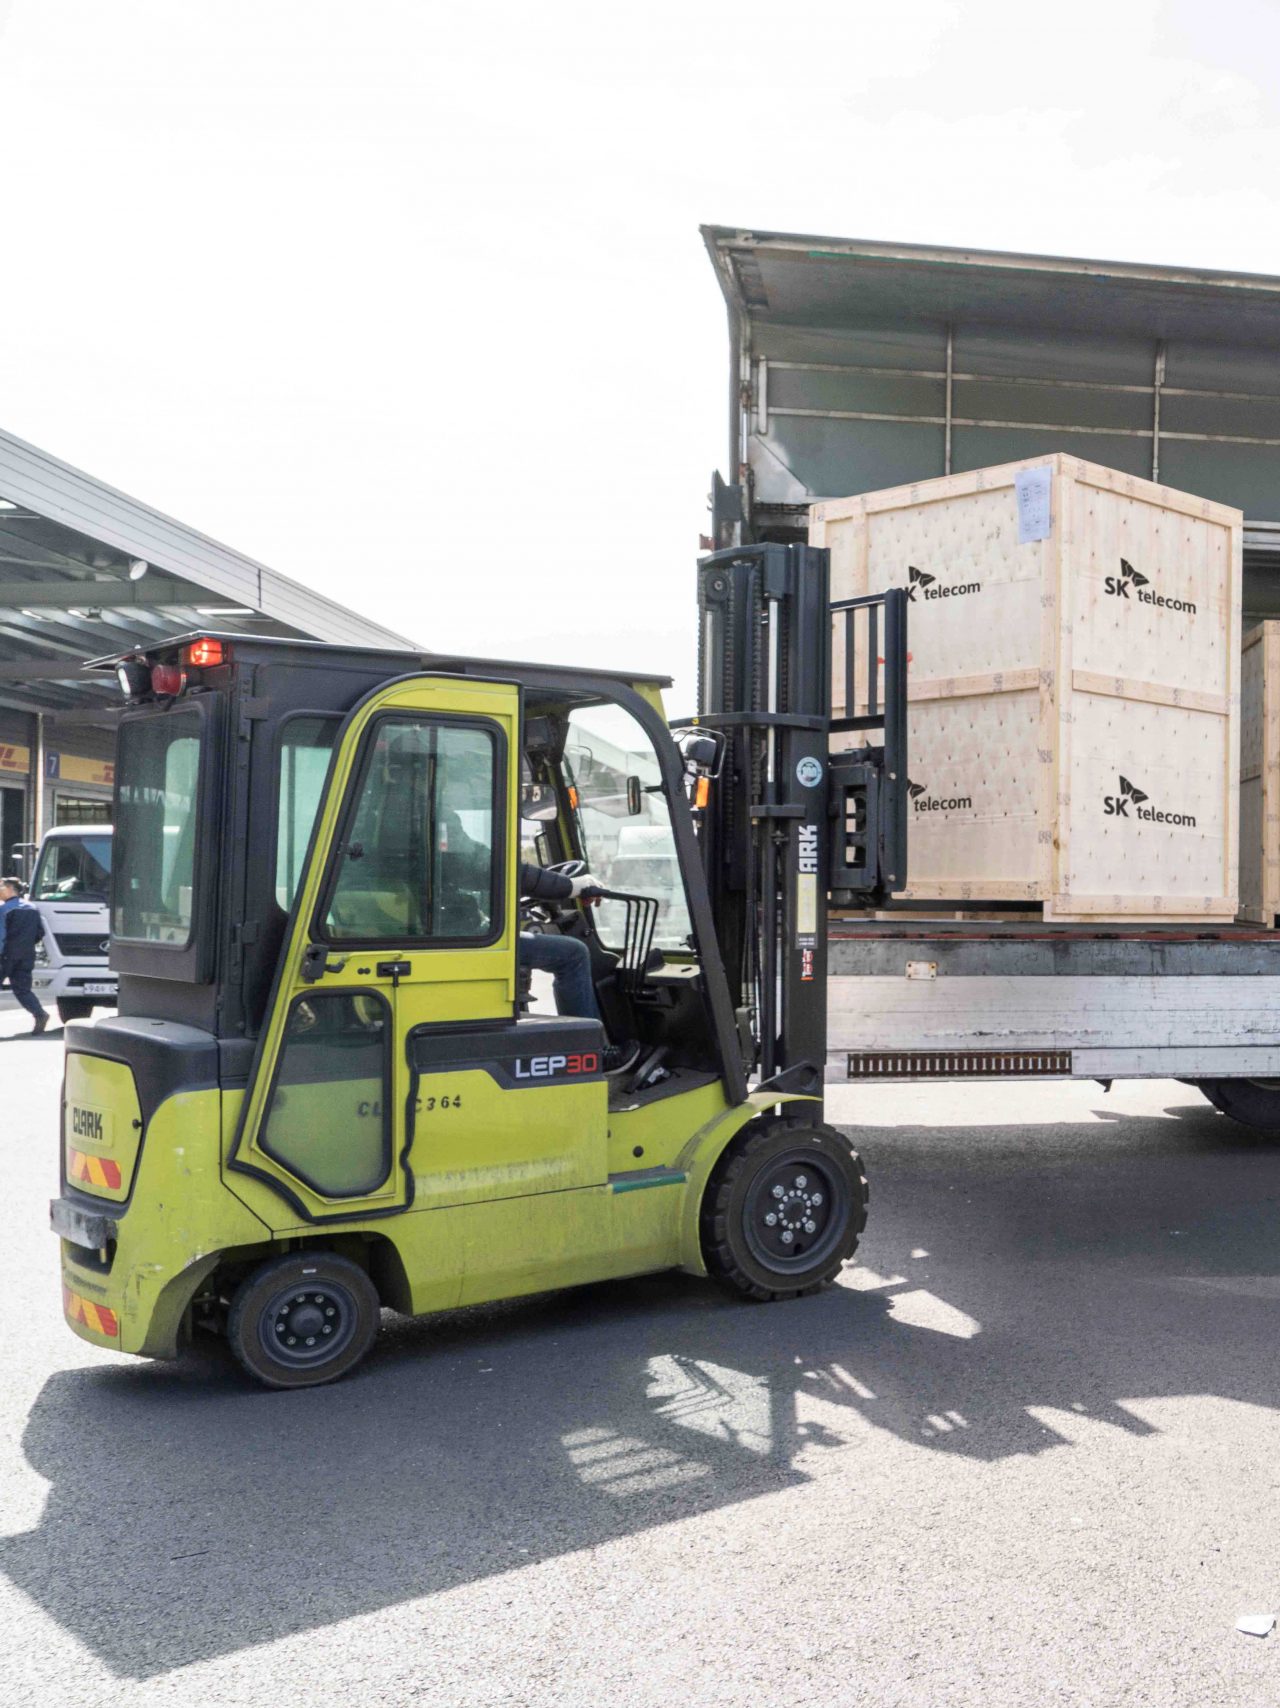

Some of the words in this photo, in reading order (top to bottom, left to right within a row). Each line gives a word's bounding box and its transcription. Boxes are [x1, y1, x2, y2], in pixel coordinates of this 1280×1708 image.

[899, 586, 917, 602] K
[924, 581, 980, 600] telecom
[1105, 576, 1130, 599] SK
[1137, 588, 1197, 615] telecom
[48, 755, 58, 774] 7
[914, 795, 972, 812] telecom
[1103, 796, 1129, 817] SK
[1137, 806, 1196, 827] telecom
[799, 825, 818, 872] ARK
[515, 1053, 598, 1078] LEP30
[73, 1106, 103, 1140] CLARK
